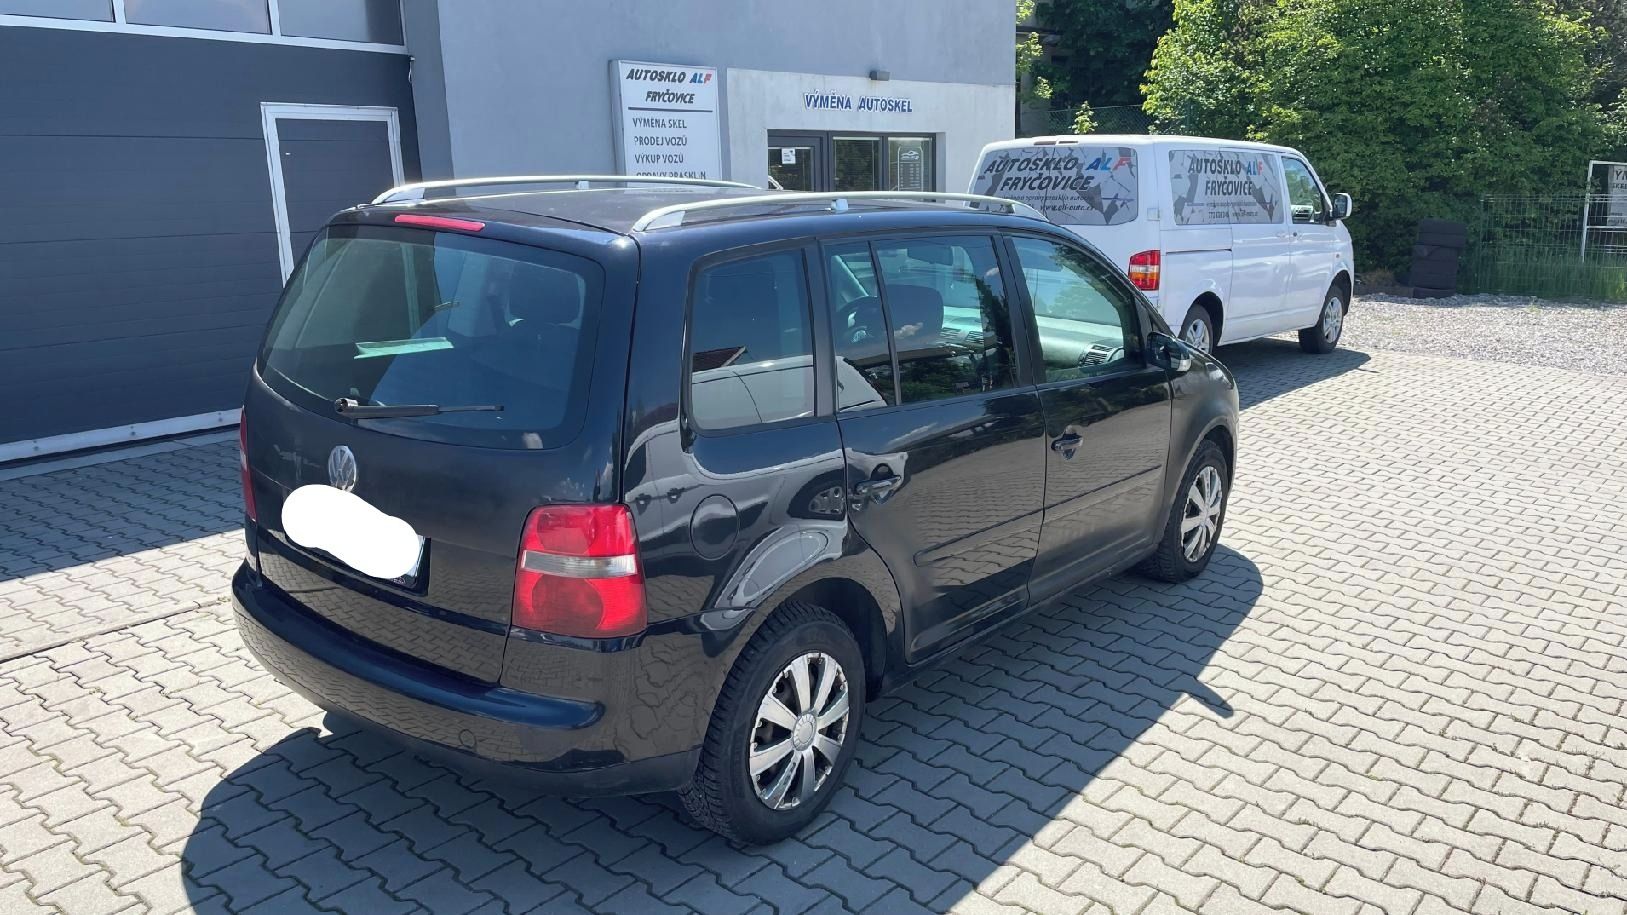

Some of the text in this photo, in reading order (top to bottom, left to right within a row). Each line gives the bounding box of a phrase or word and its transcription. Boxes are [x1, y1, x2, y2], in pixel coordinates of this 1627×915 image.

[626, 68, 712, 84] AUTOSKLO ALF
[645, 88, 695, 104] FRYČOVICE
[804, 89, 913, 113] VÝMĚNA AUTOSKEL
[668, 119, 688, 129] SKEL
[634, 135, 664, 146] PRODEJ
[634, 152, 661, 164] VÝKUP
[984, 156, 1132, 175] AUTOSKLO ALF
[1188, 158, 1264, 176] AUTOSKLO ALF
[1000, 172, 1095, 191] FRYČOVICE
[1205, 176, 1253, 196] FRYČOVICE
